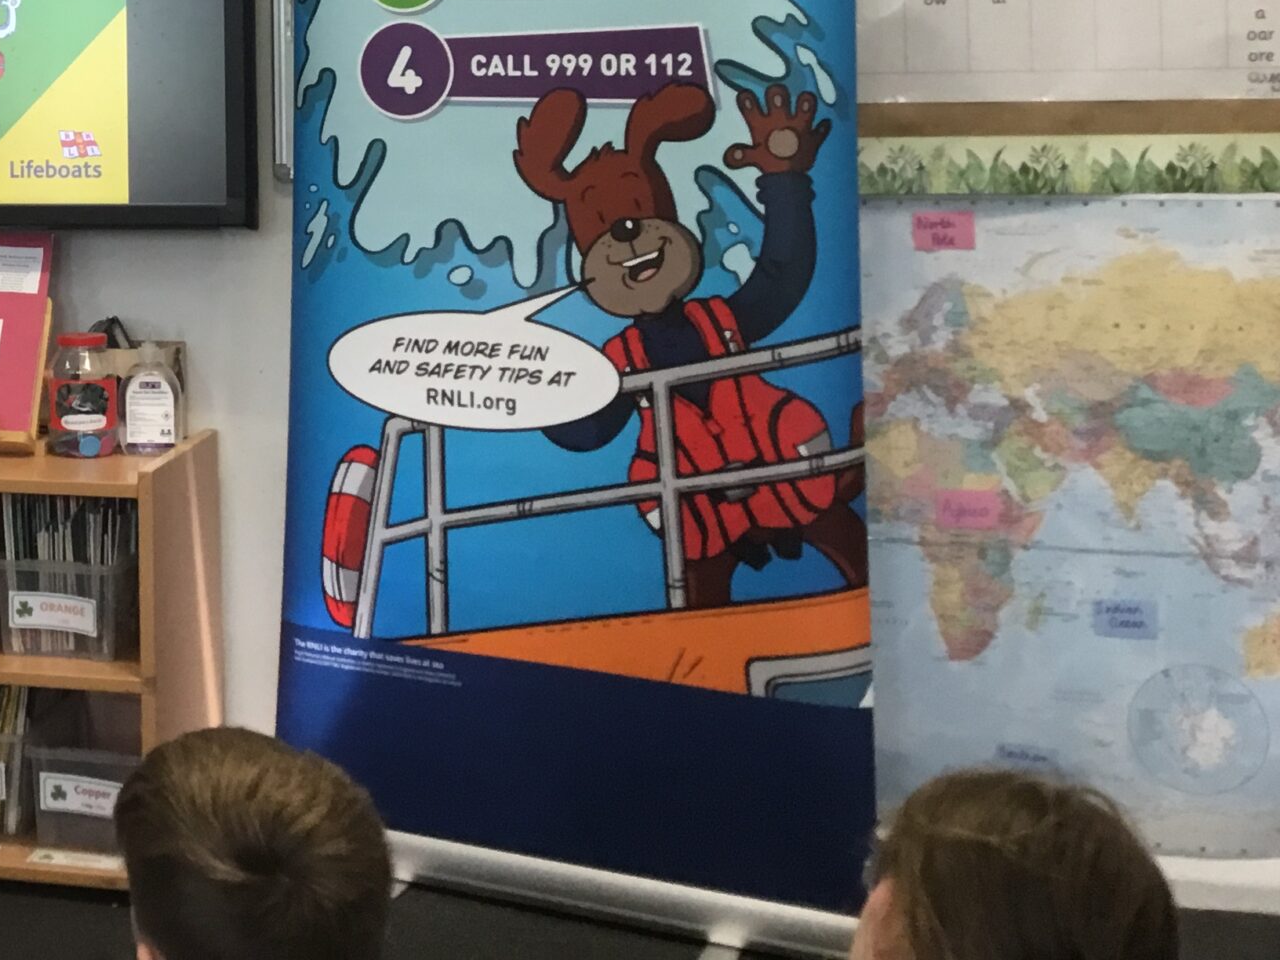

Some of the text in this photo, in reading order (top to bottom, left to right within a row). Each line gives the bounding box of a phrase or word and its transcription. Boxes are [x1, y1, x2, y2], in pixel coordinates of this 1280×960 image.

[387, 45, 693, 95] 4 CALL 999 OR 112
[10, 160, 102, 178] Lifeboats
[392, 337, 549, 361] FIND MORE FUN
[369, 359, 576, 387] AND SAFETY TIPS AT
[426, 388, 516, 416] RNLI.org
[40, 601, 86, 616] ORANGE
